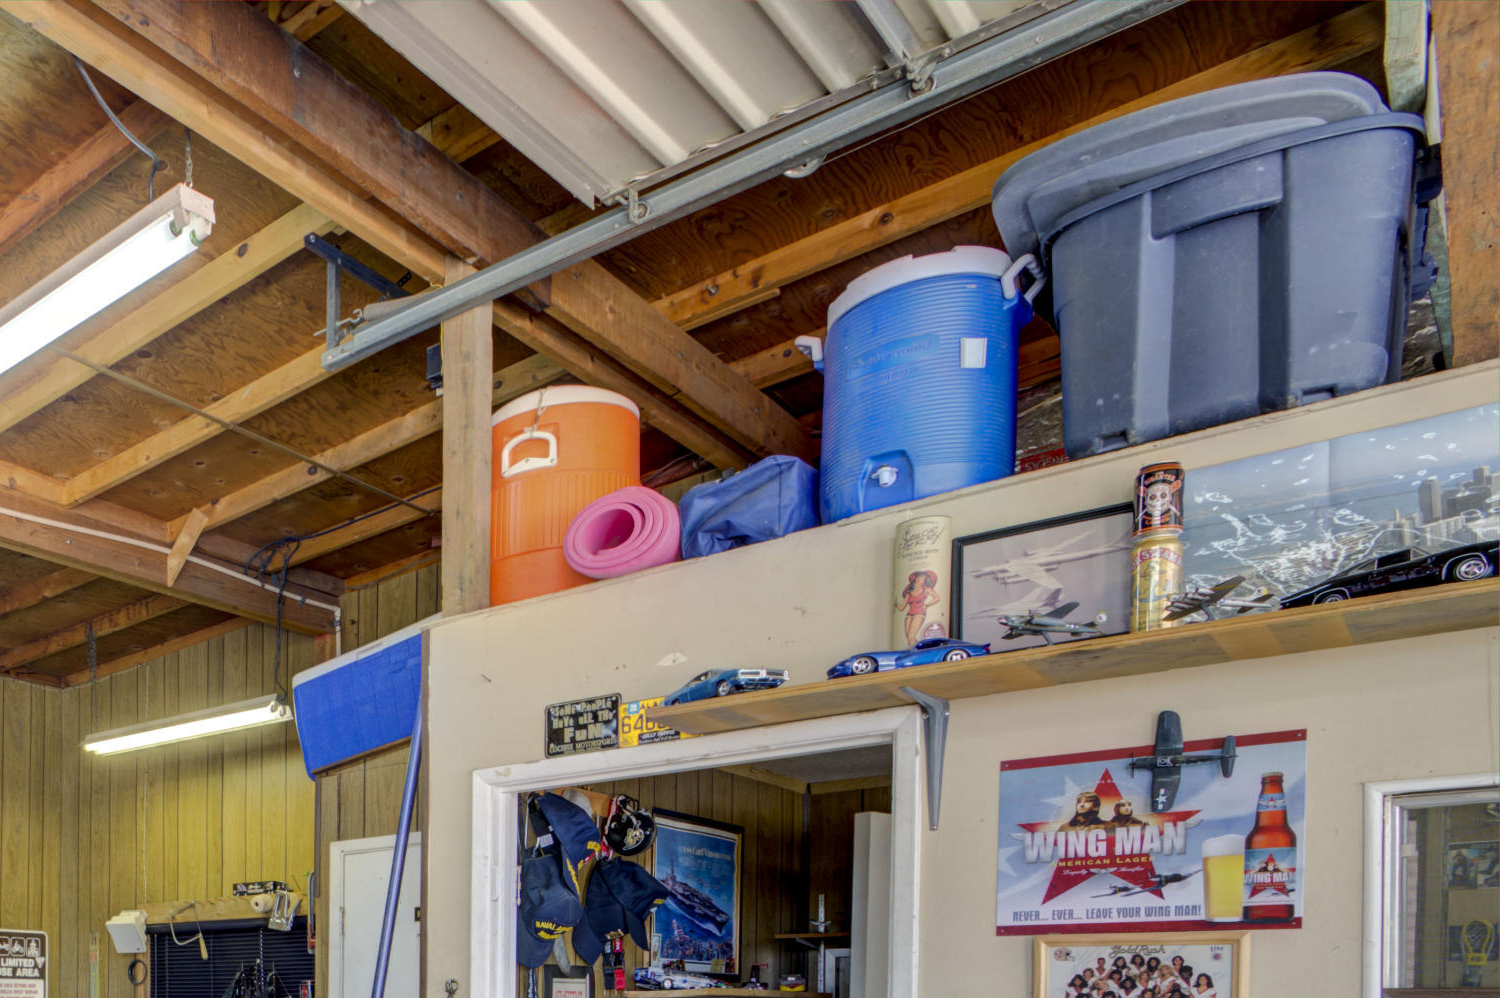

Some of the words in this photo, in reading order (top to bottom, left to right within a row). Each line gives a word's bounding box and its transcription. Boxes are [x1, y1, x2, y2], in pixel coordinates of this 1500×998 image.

[1023, 829, 1108, 865] WING
[1114, 821, 1188, 857] MAN
[1116, 856, 1156, 865] LAGER
[1085, 907, 1115, 920] LEAVE
[1116, 906, 1141, 918] YOUR
[1144, 905, 1171, 917] WING
[1175, 904, 1201, 916] MAN!
[0, 957, 35, 968] LIMITED
[16, 968, 40, 977] AREA
